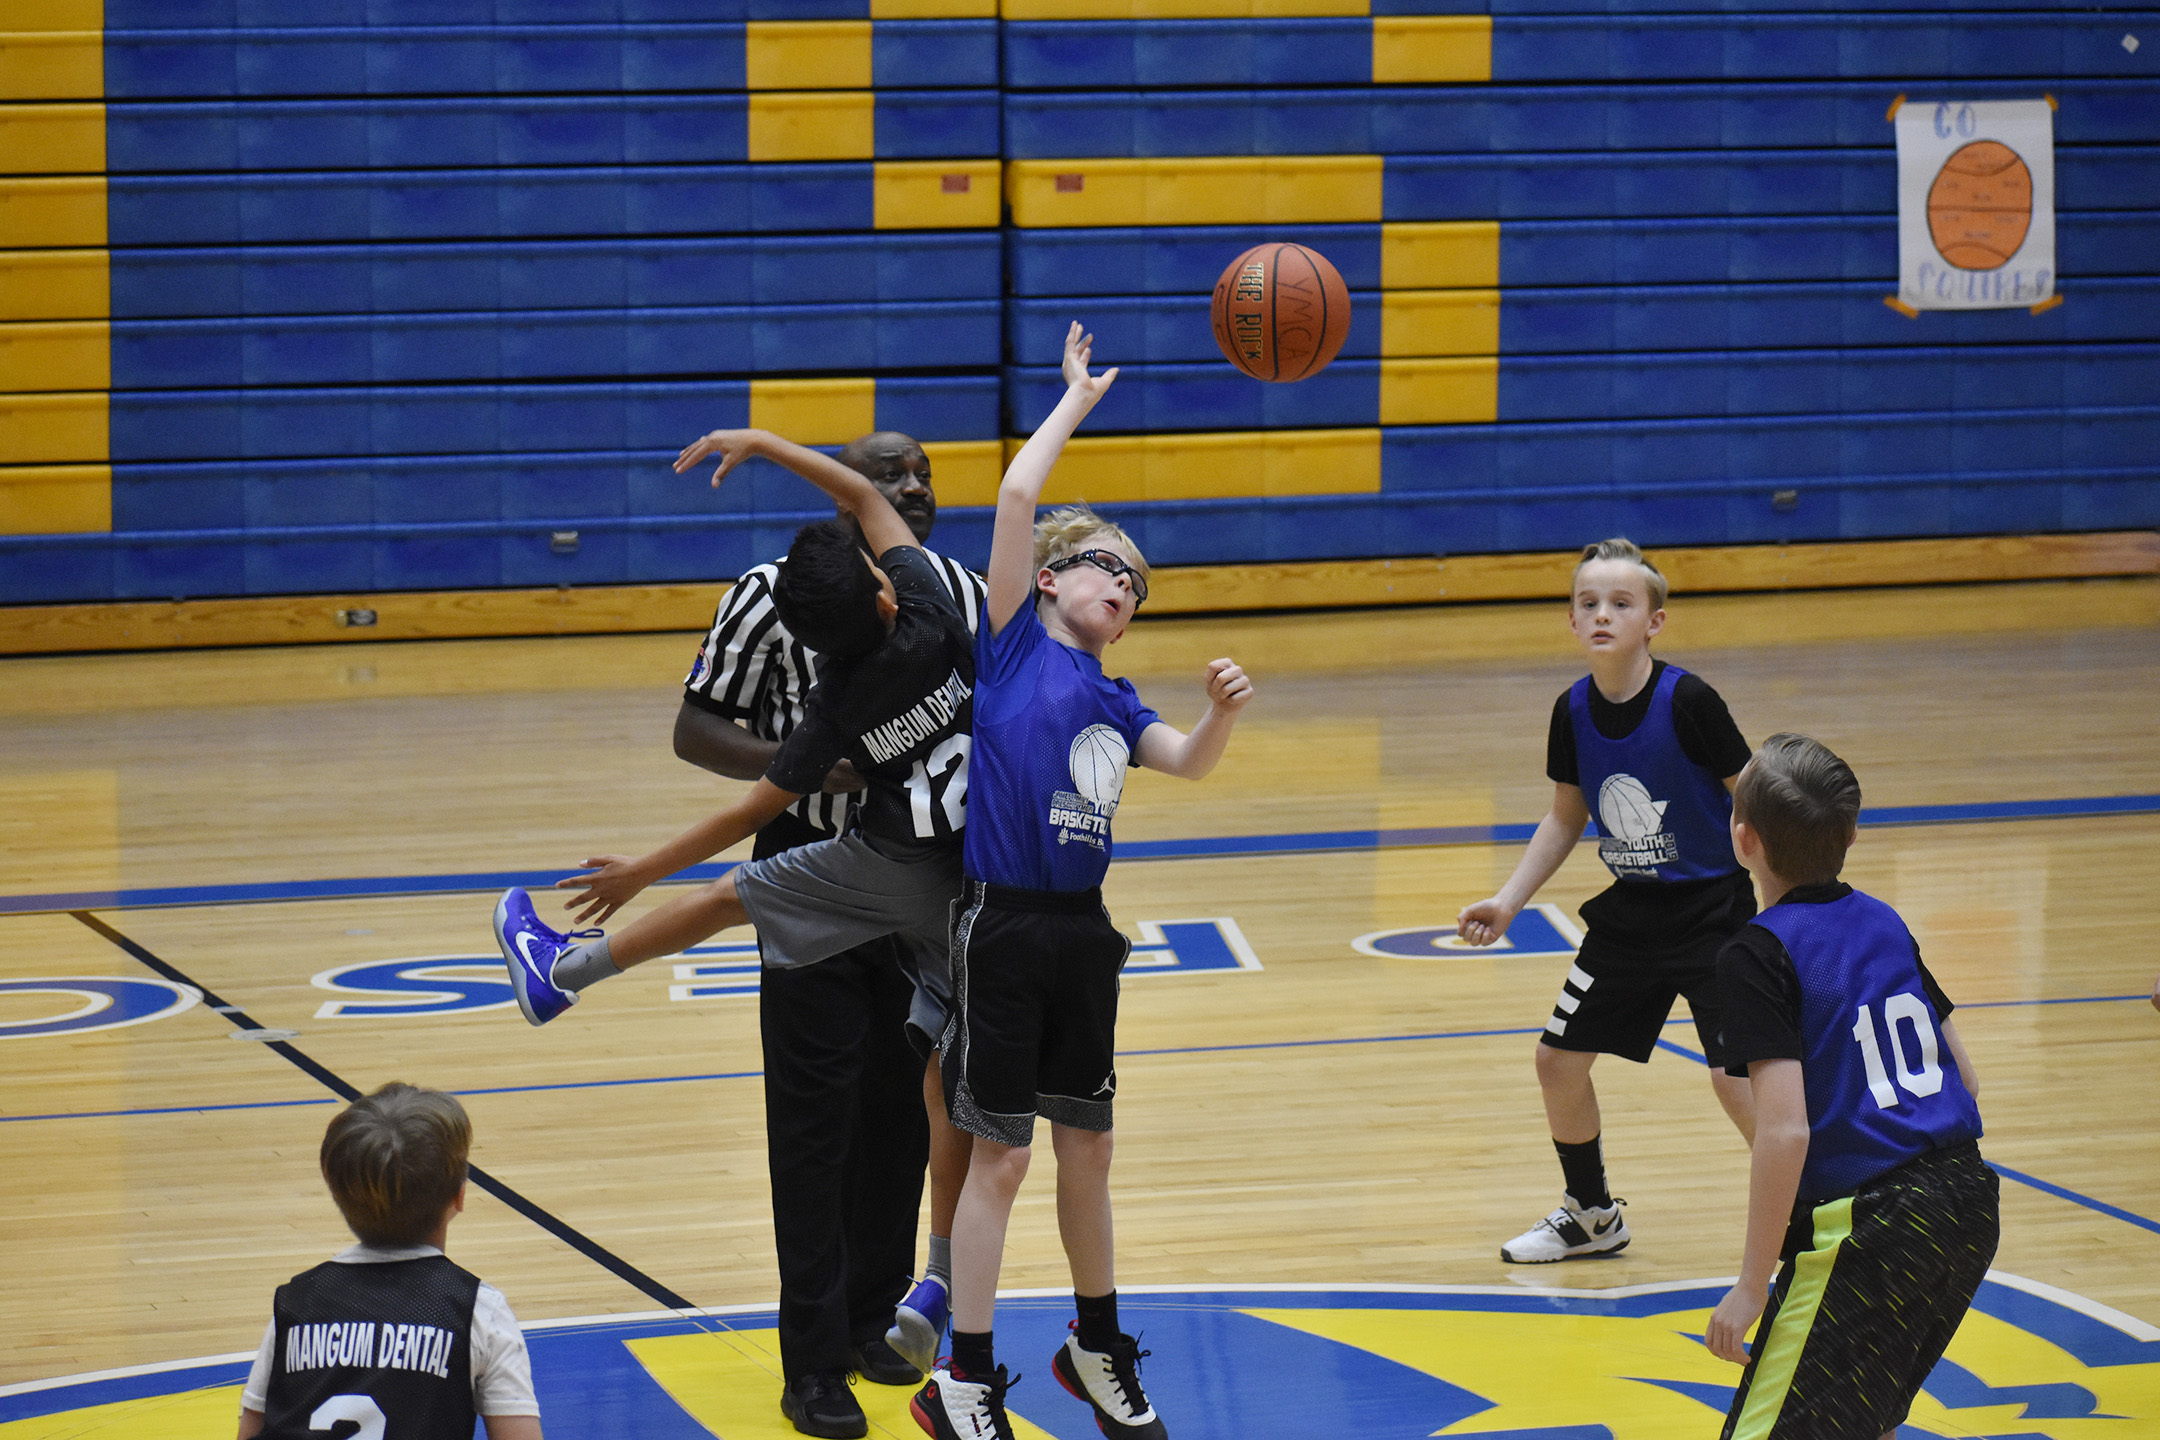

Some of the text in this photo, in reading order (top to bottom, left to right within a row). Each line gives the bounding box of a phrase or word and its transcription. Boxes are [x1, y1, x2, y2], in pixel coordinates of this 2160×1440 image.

[1235, 262, 1264, 360] THE ROCK
[1276, 277, 1314, 361] YMCA
[860, 703, 940, 764] MANGUM
[903, 733, 973, 838] 12
[1601, 849, 1668, 866] BASKETBALL
[1626, 834, 1665, 851] YOUTH
[1663, 832, 1679, 862] 2019
[1852, 992, 1944, 1109] 10
[286, 1322, 454, 1379] MANGUM DENTAL
